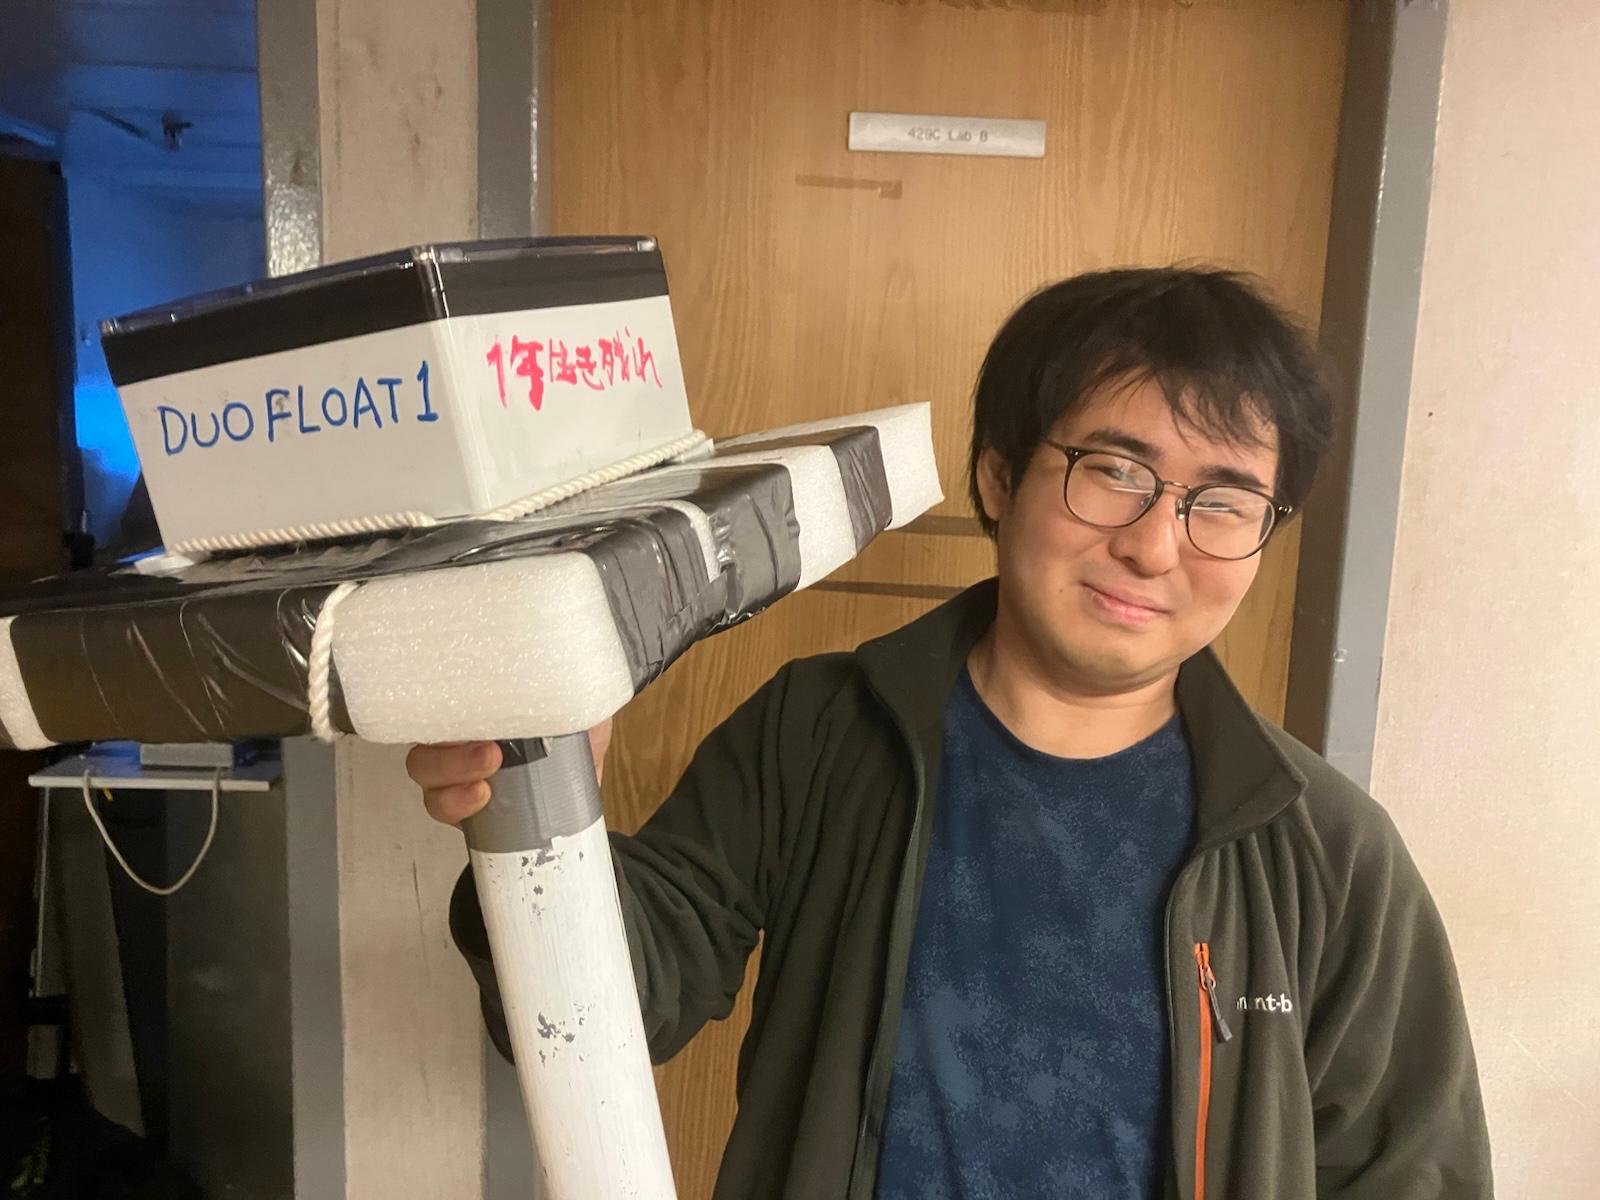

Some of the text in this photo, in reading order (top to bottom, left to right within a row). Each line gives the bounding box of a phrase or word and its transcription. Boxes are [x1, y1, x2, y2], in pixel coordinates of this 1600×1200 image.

[948, 128, 972, 142] Lab
[157, 360, 439, 455] DUO FLOAT 1
